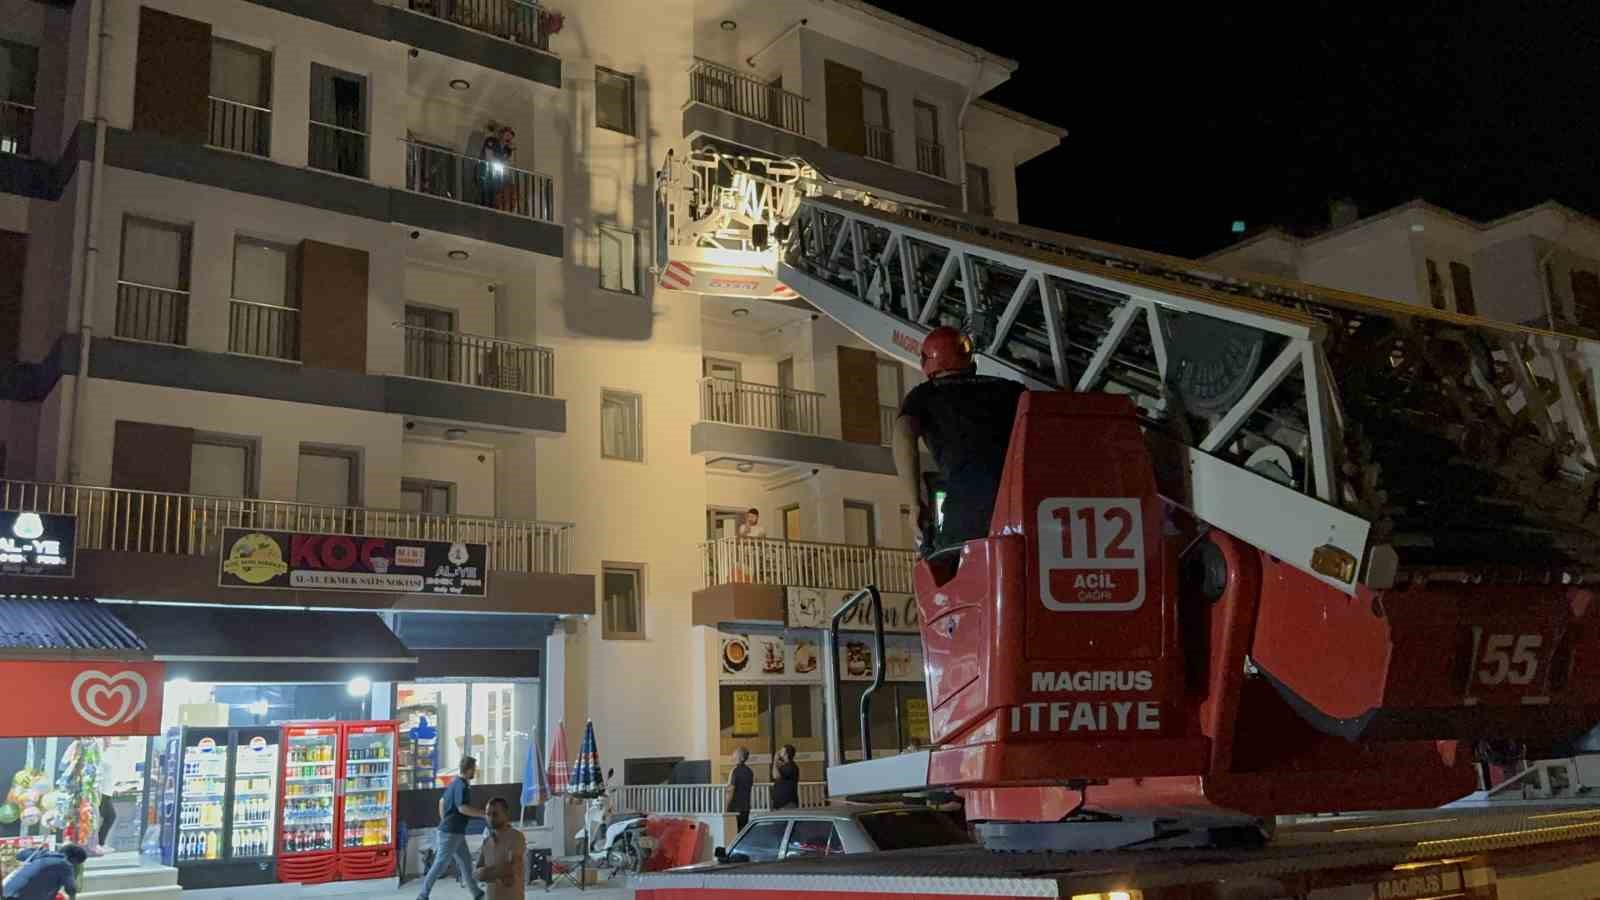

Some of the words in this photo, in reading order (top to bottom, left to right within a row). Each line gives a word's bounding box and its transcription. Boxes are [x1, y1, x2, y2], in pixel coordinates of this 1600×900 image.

[1051, 506, 1136, 560] 112
[1031, 670, 1153, 692] MAGIRUS
[1478, 633, 1543, 685] 55
